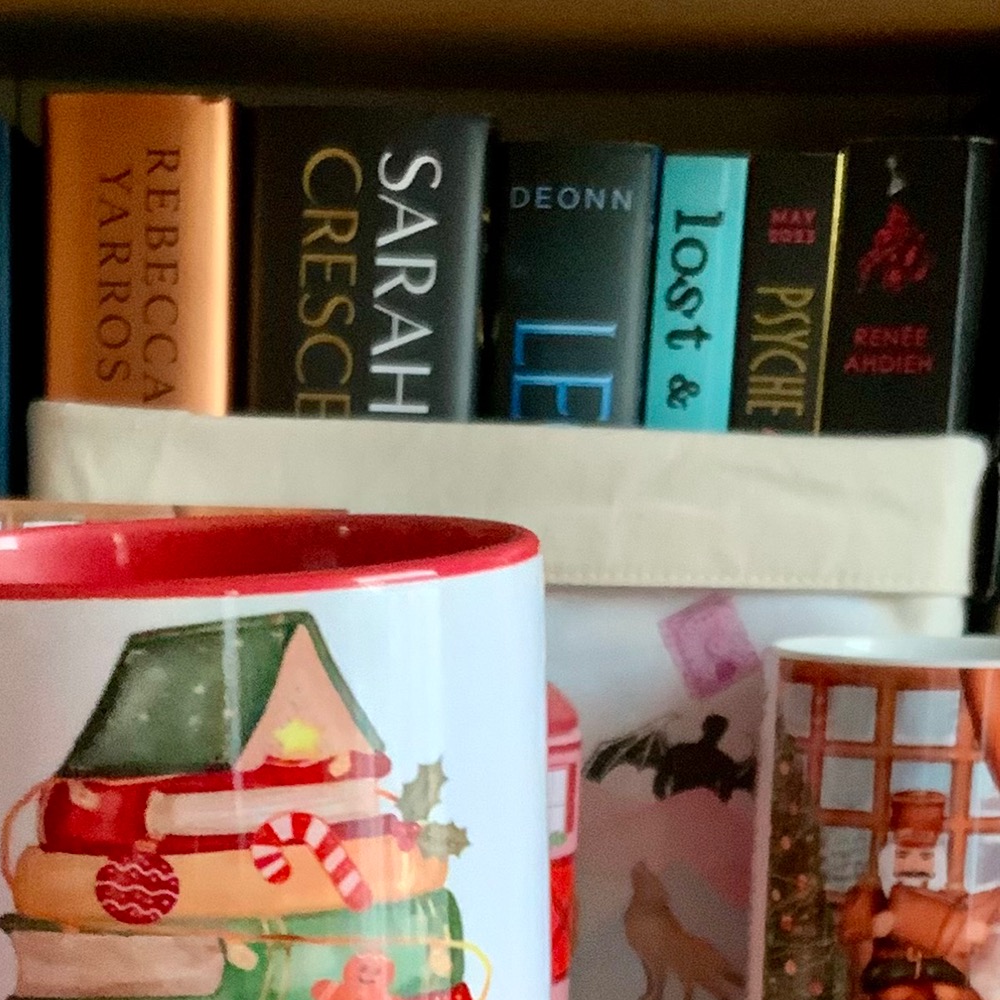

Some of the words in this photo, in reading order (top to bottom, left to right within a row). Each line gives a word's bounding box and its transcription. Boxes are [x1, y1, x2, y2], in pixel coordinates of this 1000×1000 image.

[510, 185, 634, 212] DEONN
[97, 168, 134, 383] YARROS
[143, 147, 182, 403] REBECCA
[368, 151, 443, 415] SARAH
[664, 209, 726, 351] lost
[665, 373, 701, 411] &
[745, 285, 816, 417] PSYCHE
